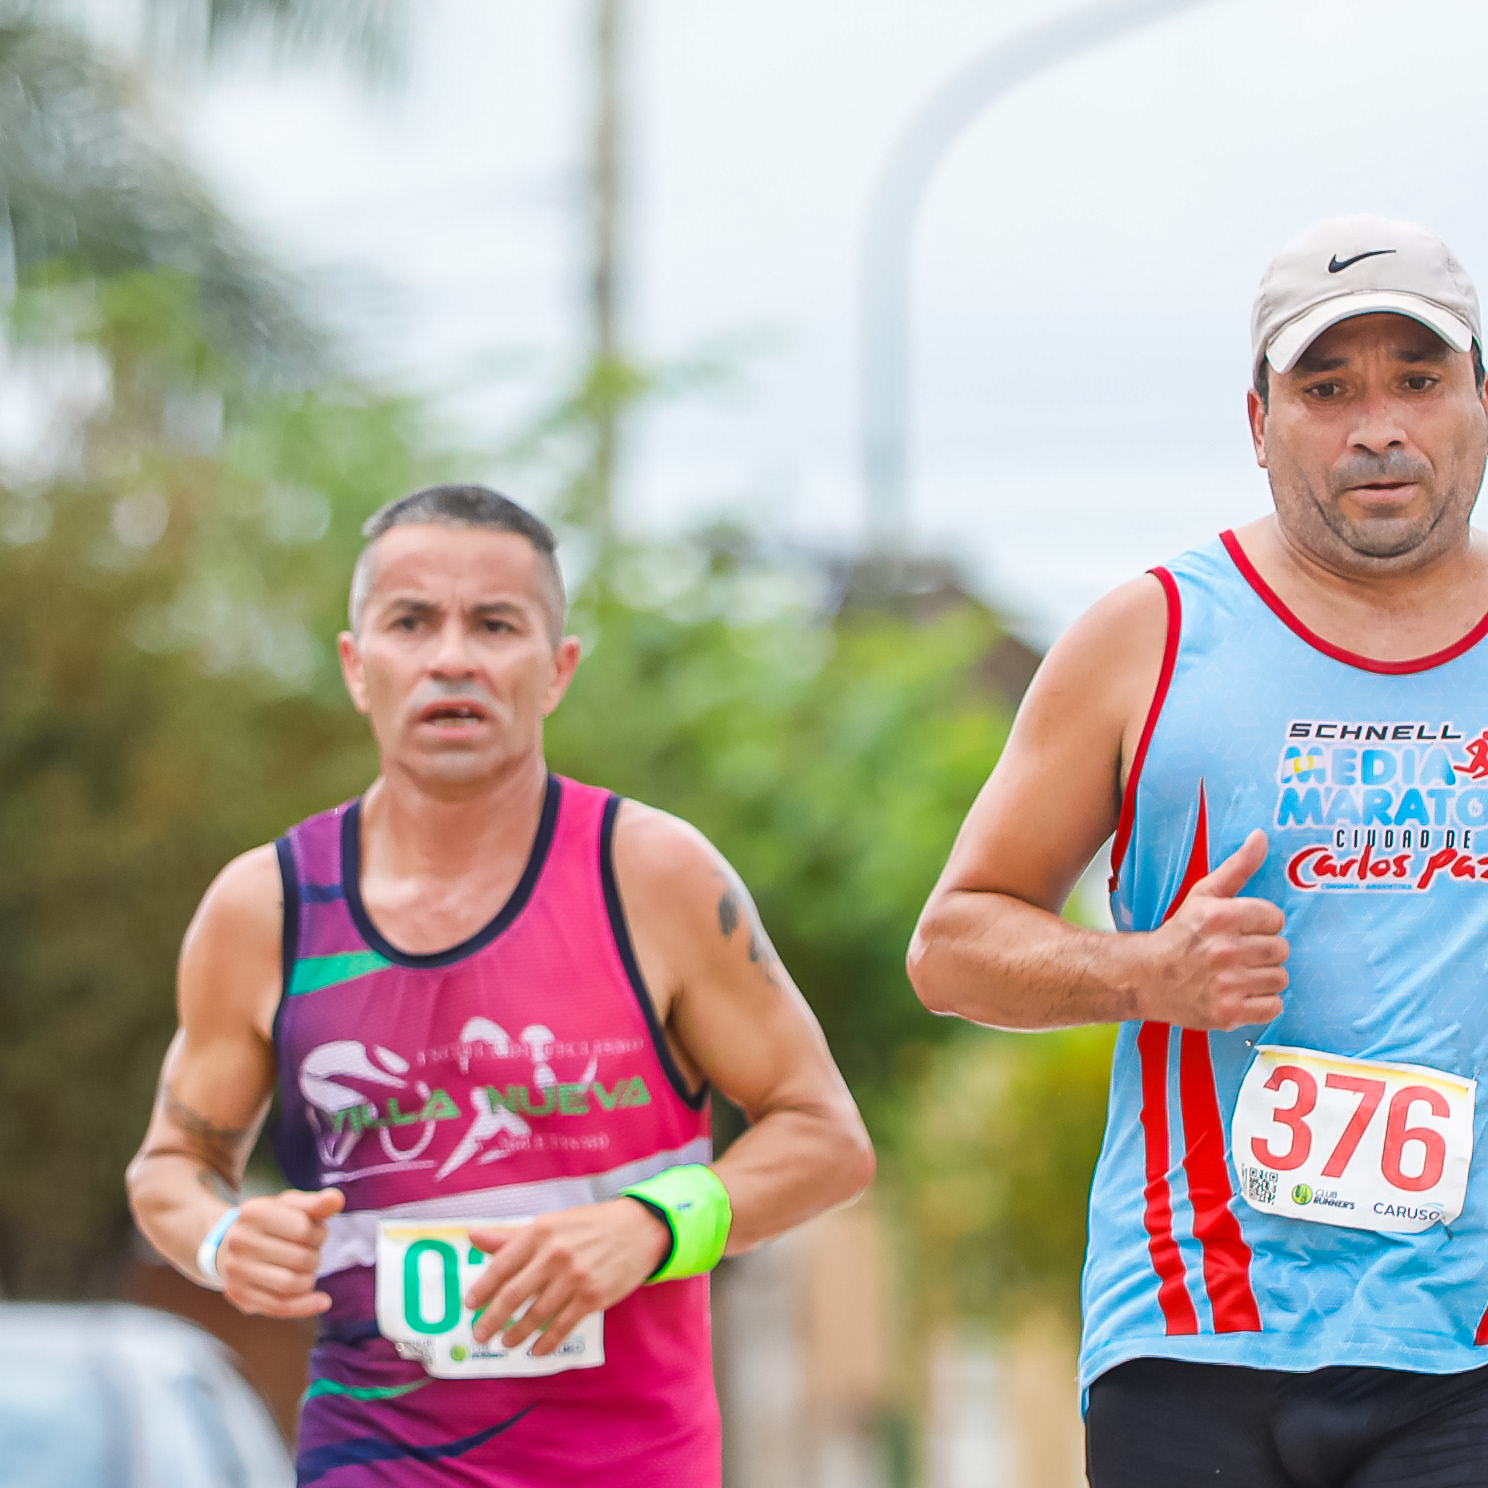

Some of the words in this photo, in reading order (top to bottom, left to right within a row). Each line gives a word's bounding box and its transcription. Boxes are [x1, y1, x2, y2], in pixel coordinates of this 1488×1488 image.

[1288, 723, 1462, 741] SCHNELL
[1280, 745, 1457, 787] MEDIA
[1336, 829, 1430, 849] CIUDAD
[1446, 829, 1472, 849] DE
[1287, 844, 1412, 889] Carlos
[484, 1074, 652, 1117] NUEVA
[1250, 1065, 1451, 1192] 376
[1315, 1188, 1338, 1199] CLUB
[1373, 1202, 1441, 1221] CARUSO
